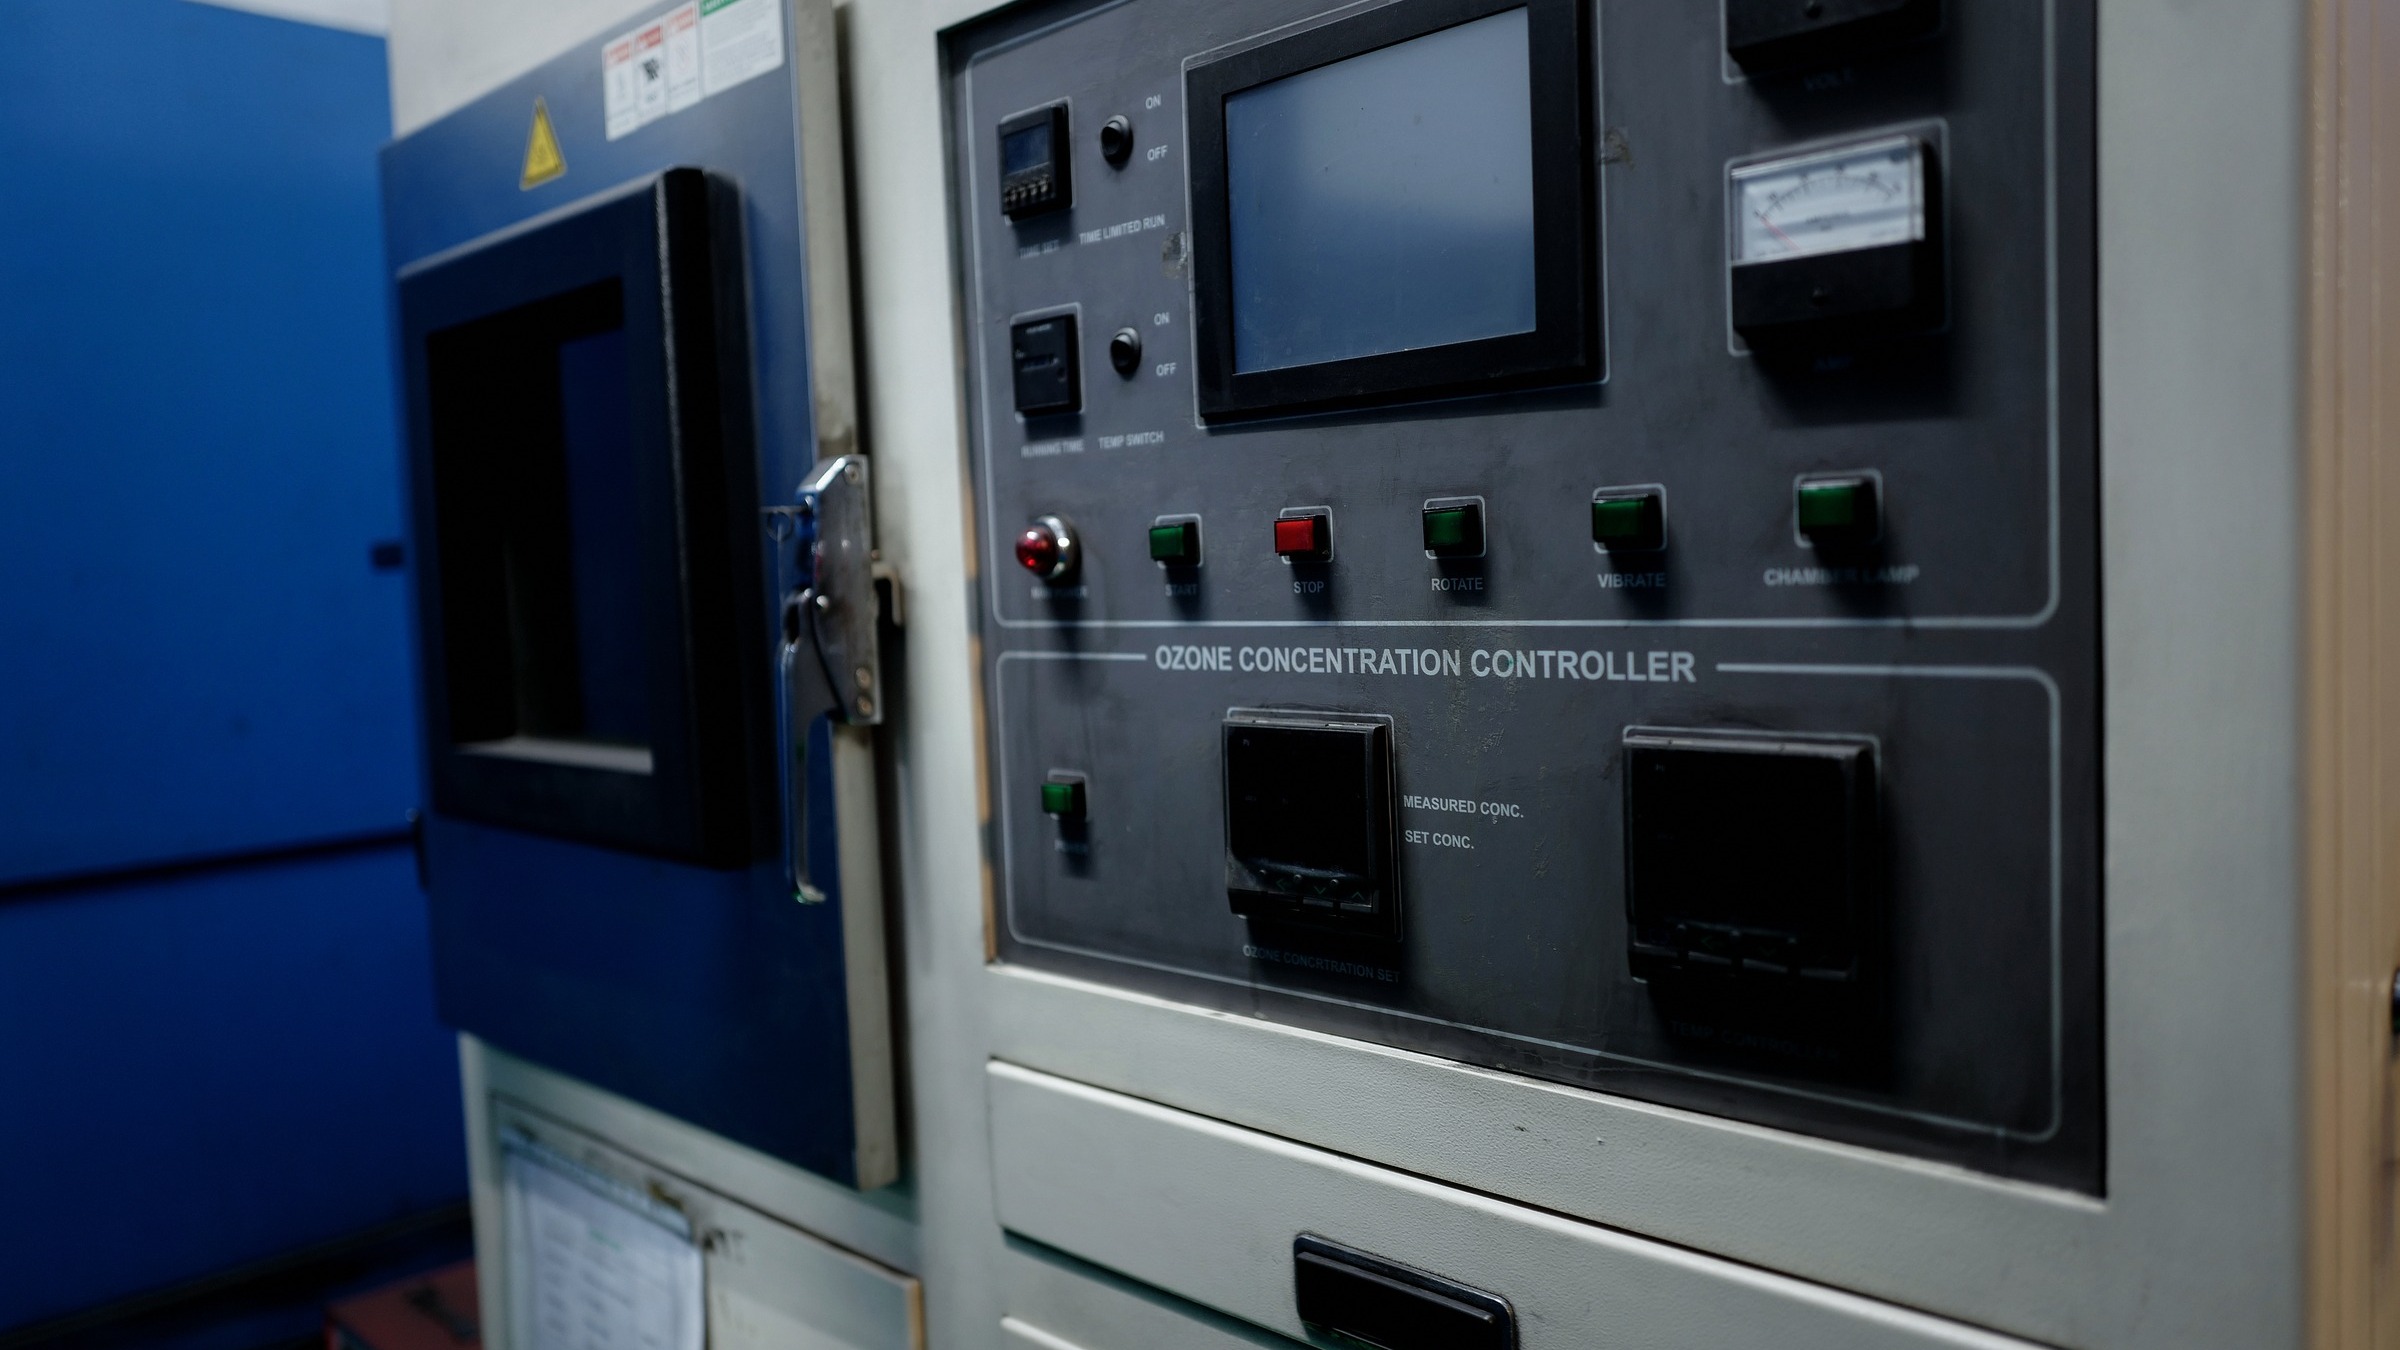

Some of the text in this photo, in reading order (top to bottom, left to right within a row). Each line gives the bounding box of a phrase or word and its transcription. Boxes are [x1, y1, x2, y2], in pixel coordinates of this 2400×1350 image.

[1145, 94, 1161, 110] ON
[1147, 144, 1168, 161] OFF
[1079, 213, 1165, 245] TIME LIMITED RUN
[1154, 312, 1170, 326] ON
[1156, 362, 1177, 378] OFF
[1099, 430, 1164, 449] TEMP SWITCH
[1293, 580, 1325, 594] STOP
[1431, 576, 1484, 591] ROTATE
[1597, 571, 1666, 588] VIBRATE
[1155, 645, 1697, 683] OZONE CONCENTRATION CONTROLLER
[1403, 795, 1524, 818] MEASURED CONC.
[1405, 830, 1475, 849] SET CONC.
[1242, 945, 1400, 984] OZONE CONCRTRATION SET
